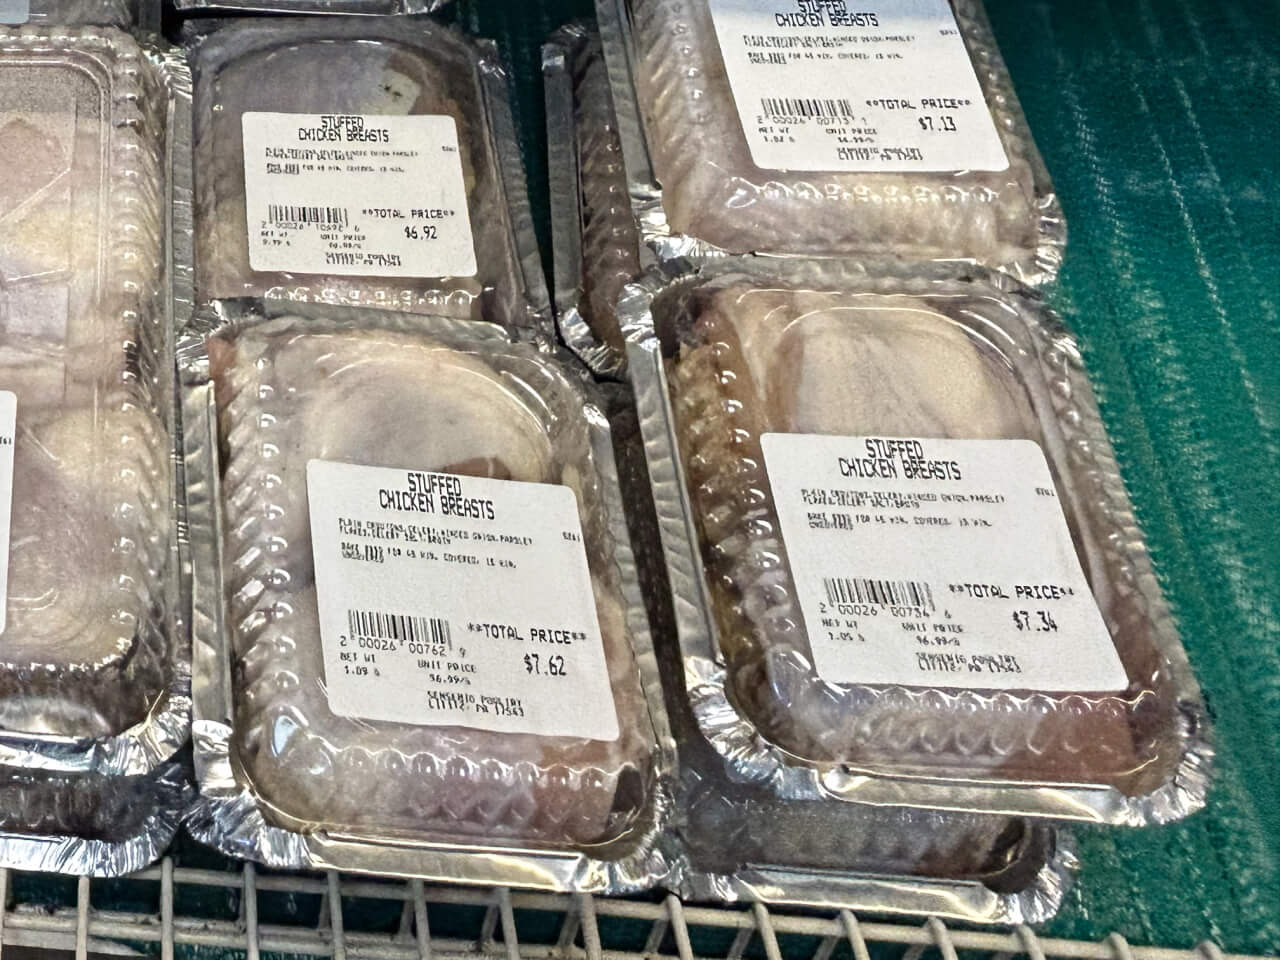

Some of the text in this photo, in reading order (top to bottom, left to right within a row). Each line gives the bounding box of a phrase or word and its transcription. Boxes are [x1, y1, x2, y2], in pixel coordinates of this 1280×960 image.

[797, 0, 847, 14] STUFFED
[775, 13, 879, 27] CHICKEN BREASTS
[320, 116, 365, 130] STUFFED
[918, 116, 958, 132] $7.13
[298, 128, 389, 143] CHICKEN BREASTS
[404, 225, 438, 240] $6.92
[865, 439, 924, 459] STUFFED
[838, 457, 962, 480] CHICKEN BREASTS
[407, 472, 462, 497] STUFFED
[379, 489, 496, 520] CHICKEN BREASTS
[819, 602, 827, 613] 2
[838, 604, 878, 616] 00026
[1013, 610, 1059, 633] $7.34
[339, 635, 467, 658] 2 00026 00762 9
[417, 659, 441, 670] UNIT
[447, 663, 477, 673] PRICE
[523, 653, 568, 677] $7.62
